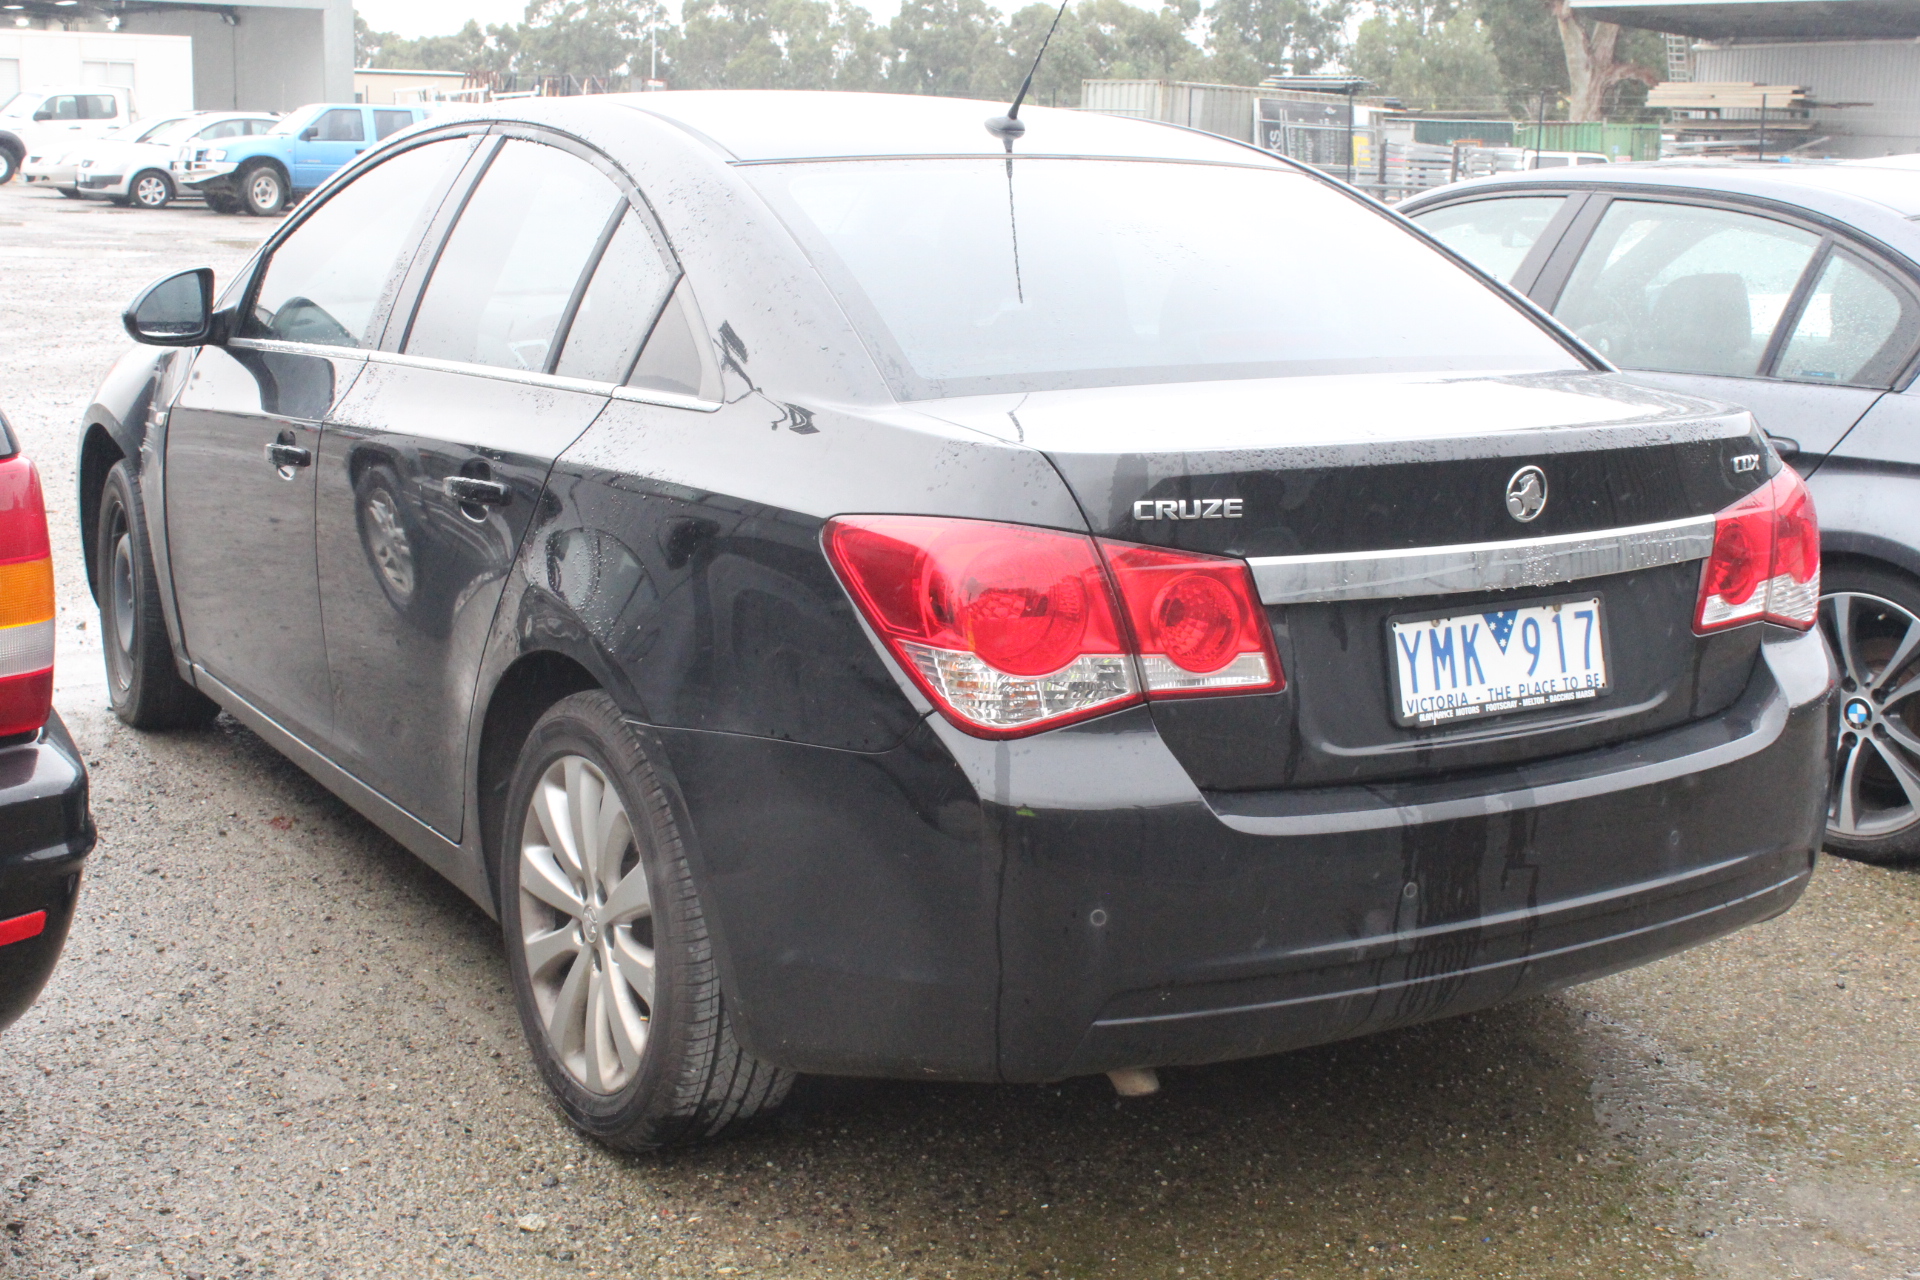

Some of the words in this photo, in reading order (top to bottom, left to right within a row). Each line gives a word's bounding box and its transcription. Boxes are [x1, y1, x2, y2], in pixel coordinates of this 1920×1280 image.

[1133, 498, 1244, 520] CRUZE
[1398, 622, 1486, 694] YMK
[1521, 609, 1594, 678] 917
[1406, 692, 1469, 714] VICTORIA
[1487, 685, 1511, 702] THE
[1518, 678, 1556, 697] PLACE
[1562, 676, 1579, 692] TO
[1585, 672, 1600, 688] BE
[1455, 705, 1480, 717] MOTORS
[1485, 699, 1518, 712] FOOTSCRAY
[1522, 696, 1545, 707] MELTON
[1549, 691, 1575, 703] BACCHUS
[1575, 689, 1596, 700] MARSH
